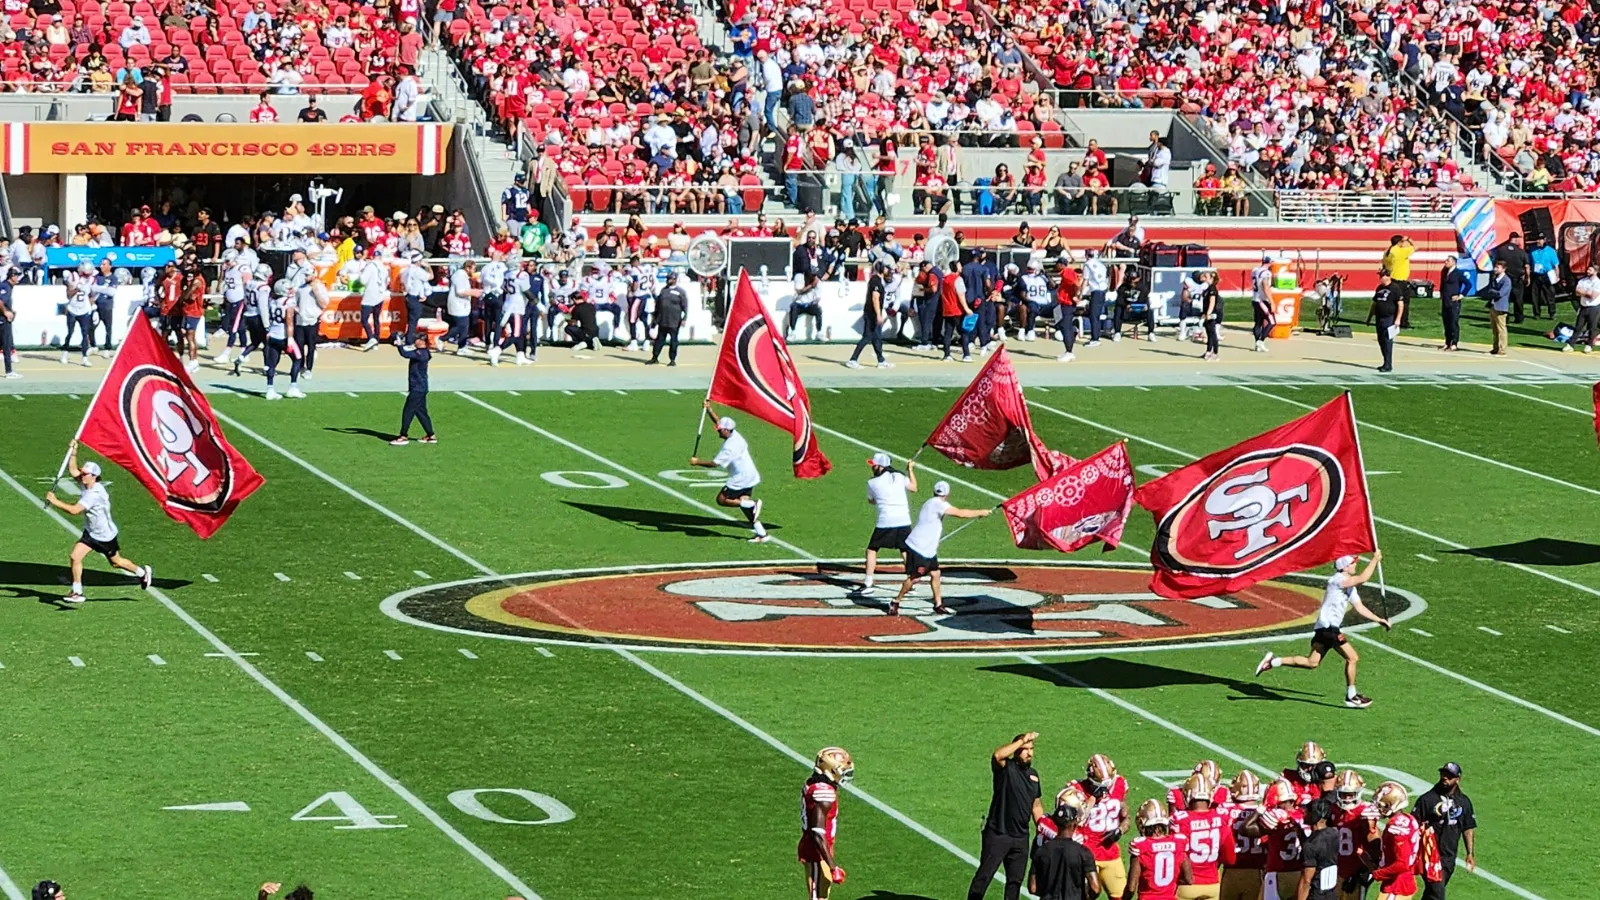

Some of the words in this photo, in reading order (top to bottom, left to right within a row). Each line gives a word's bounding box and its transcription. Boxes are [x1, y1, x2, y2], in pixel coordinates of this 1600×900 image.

[51, 142, 117, 156] SAN
[126, 142, 299, 156] FRANCISCO
[306, 143, 396, 156] 49ERS
[515, 193, 528, 208] 12
[1204, 467, 1309, 560] SF
[1088, 798, 1121, 833] 82
[1189, 828, 1221, 864] 51
[1154, 851, 1175, 887] 0
